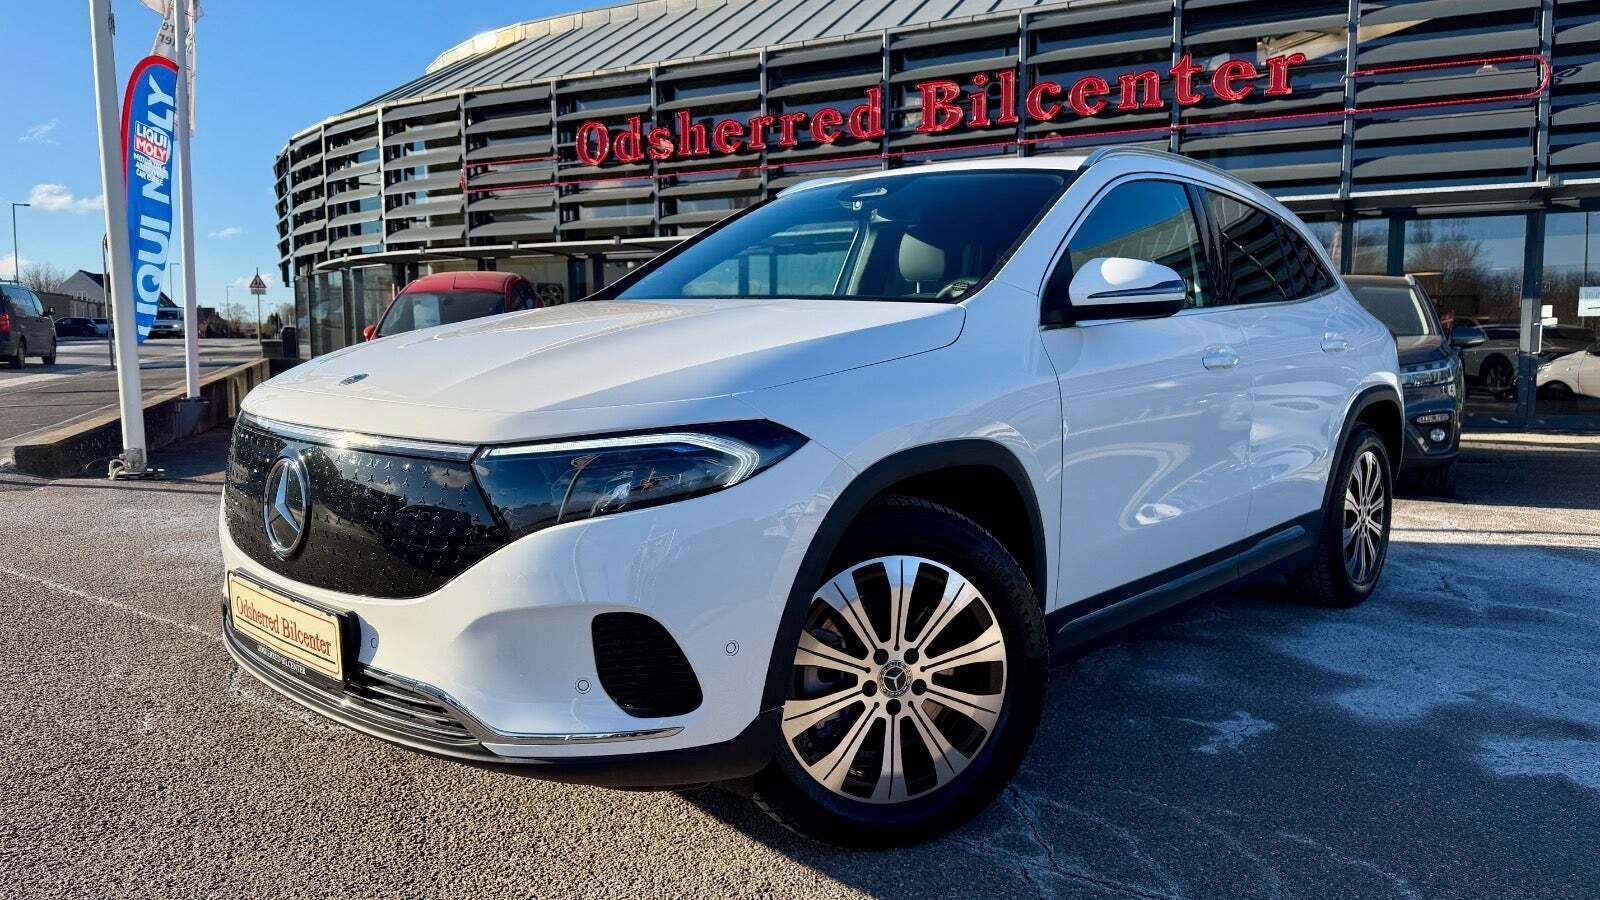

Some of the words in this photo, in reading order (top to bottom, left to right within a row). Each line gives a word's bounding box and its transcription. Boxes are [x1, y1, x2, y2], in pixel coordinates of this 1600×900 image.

[574, 86, 886, 167] Odsherred
[916, 51, 1307, 134] Bilcenter
[135, 137, 168, 163] MOLY
[136, 122, 168, 149] LIQUI
[236, 595, 280, 634] Odsherred
[280, 616, 332, 657] Bilcenter
